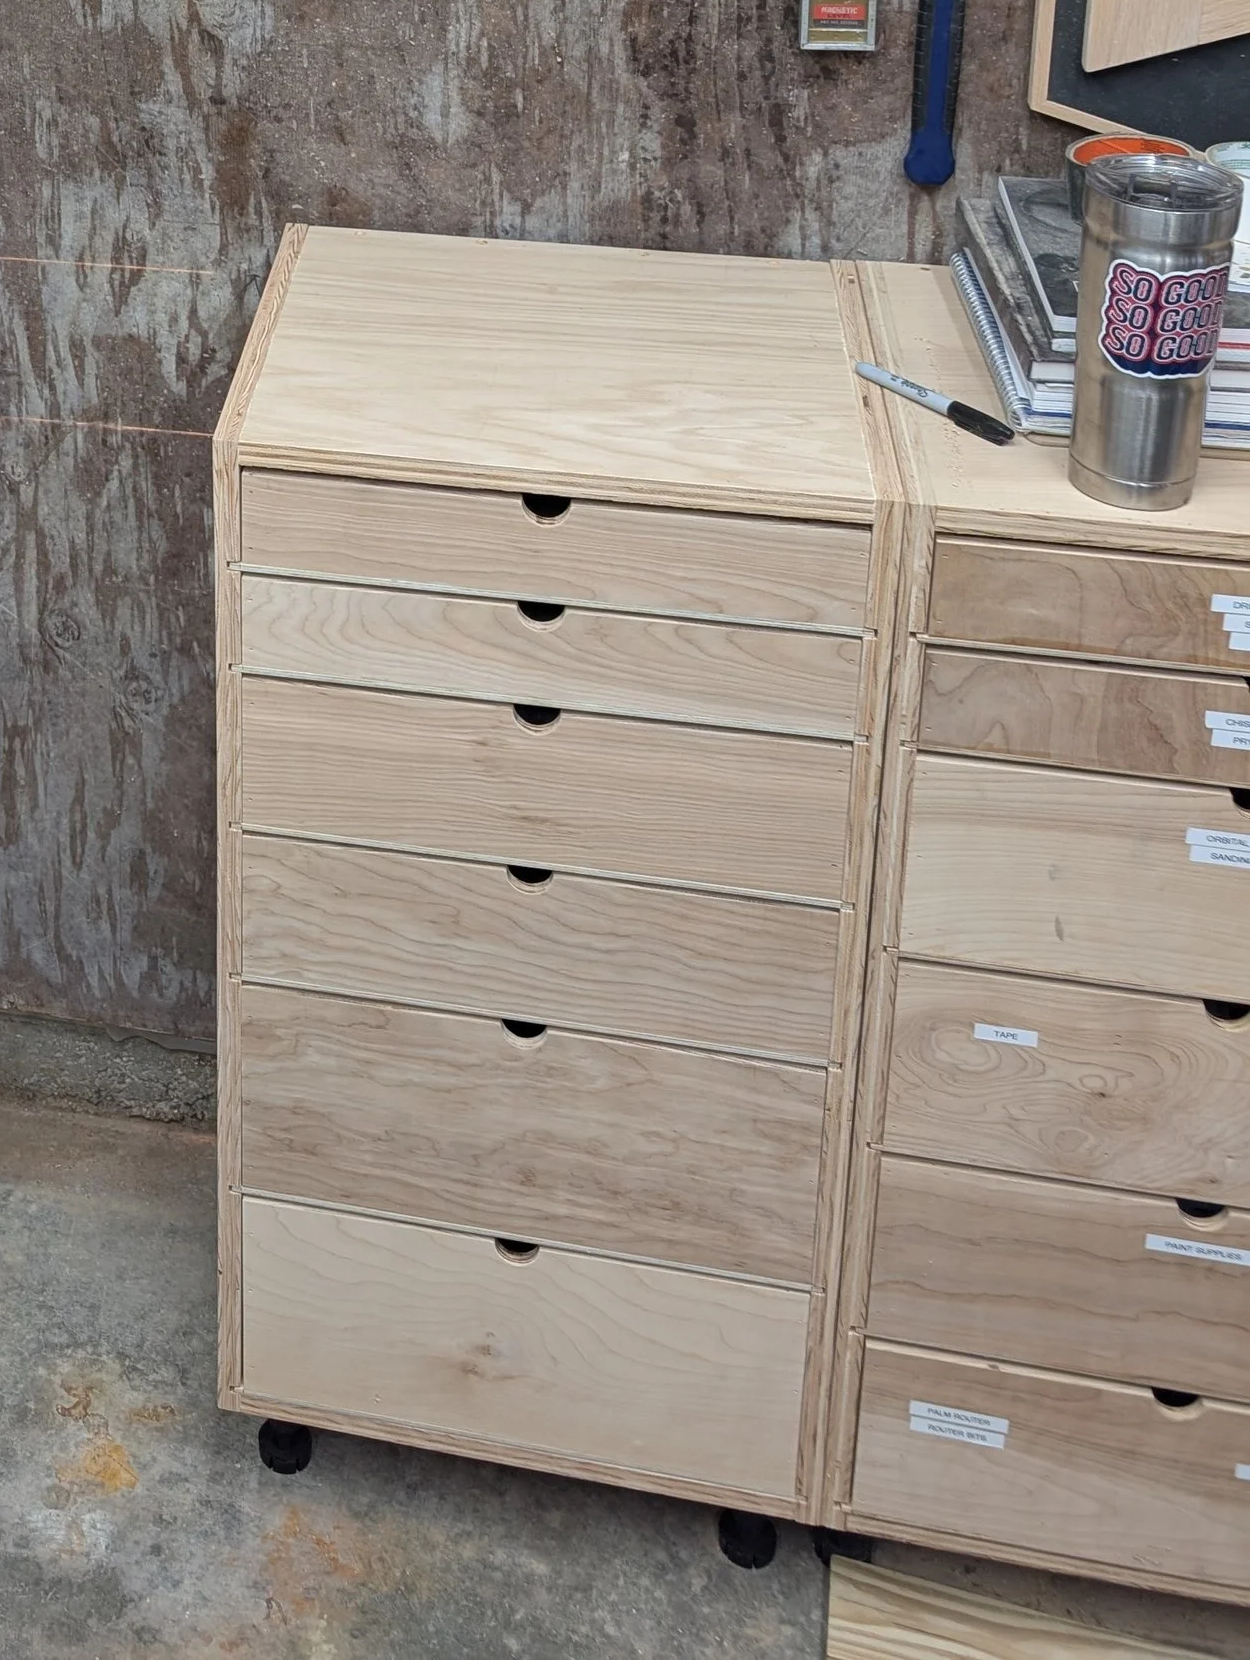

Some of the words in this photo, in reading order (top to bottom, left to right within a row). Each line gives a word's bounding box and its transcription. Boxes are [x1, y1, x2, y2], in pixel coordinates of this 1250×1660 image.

[1112, 267, 1154, 303] SO
[1109, 296, 1150, 331] SO
[1106, 324, 1147, 359] SO
[993, 1029, 1019, 1041] TAPE
[1164, 1241, 1193, 1252] PAINT
[1195, 1246, 1244, 1261] SUPPLIES
[927, 1407, 951, 1418] PALM
[953, 1412, 991, 1427] ROUTER
[927, 1423, 965, 1438] ROUTER
[966, 1431, 988, 1442] BITS
